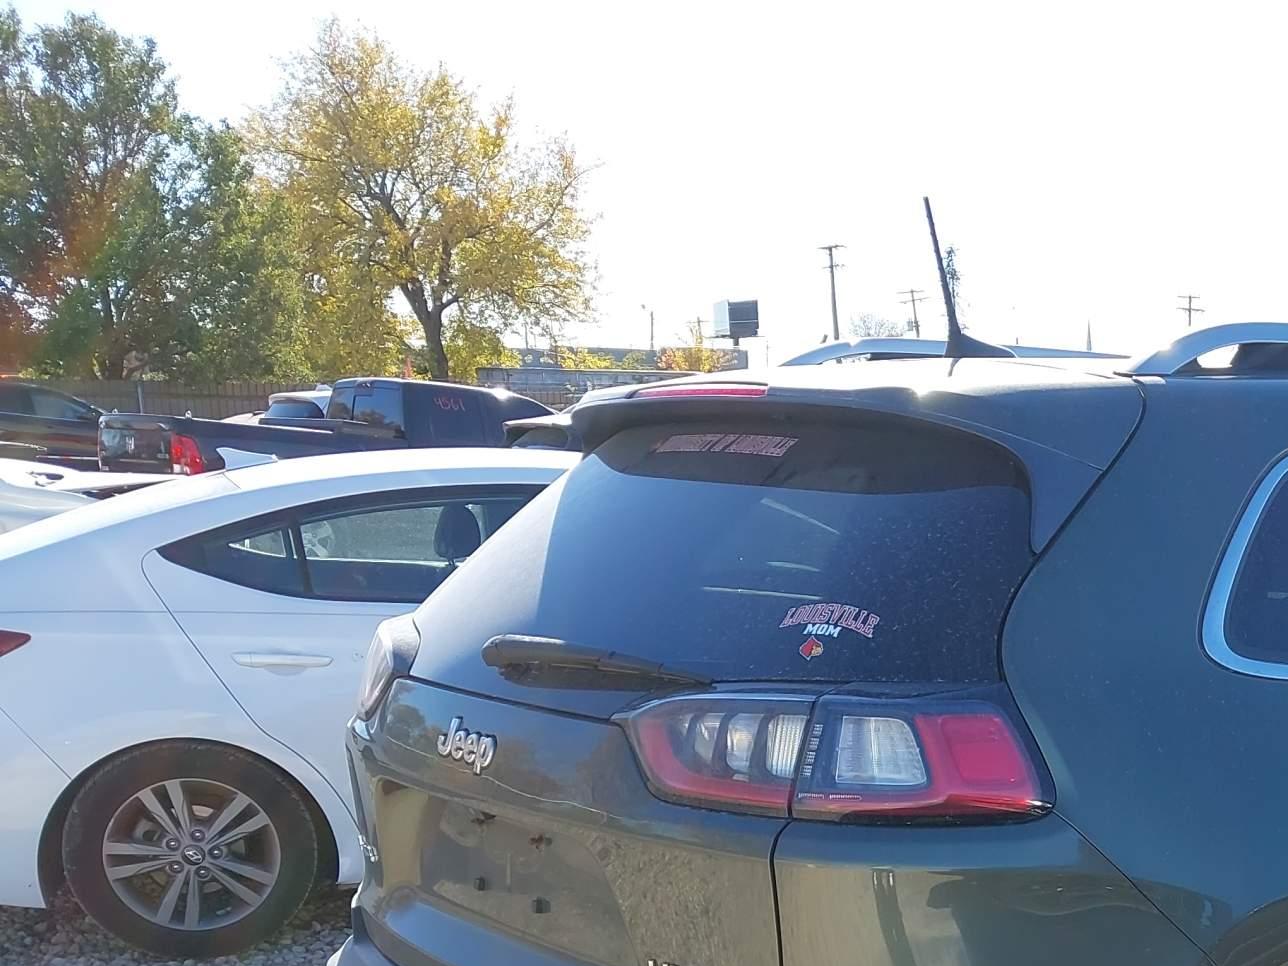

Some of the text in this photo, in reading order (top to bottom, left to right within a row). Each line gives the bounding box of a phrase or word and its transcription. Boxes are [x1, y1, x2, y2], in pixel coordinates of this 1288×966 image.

[779, 603, 880, 639] LOUISVILLE
[803, 623, 842, 638] MOM
[437, 716, 498, 776] Jeep
